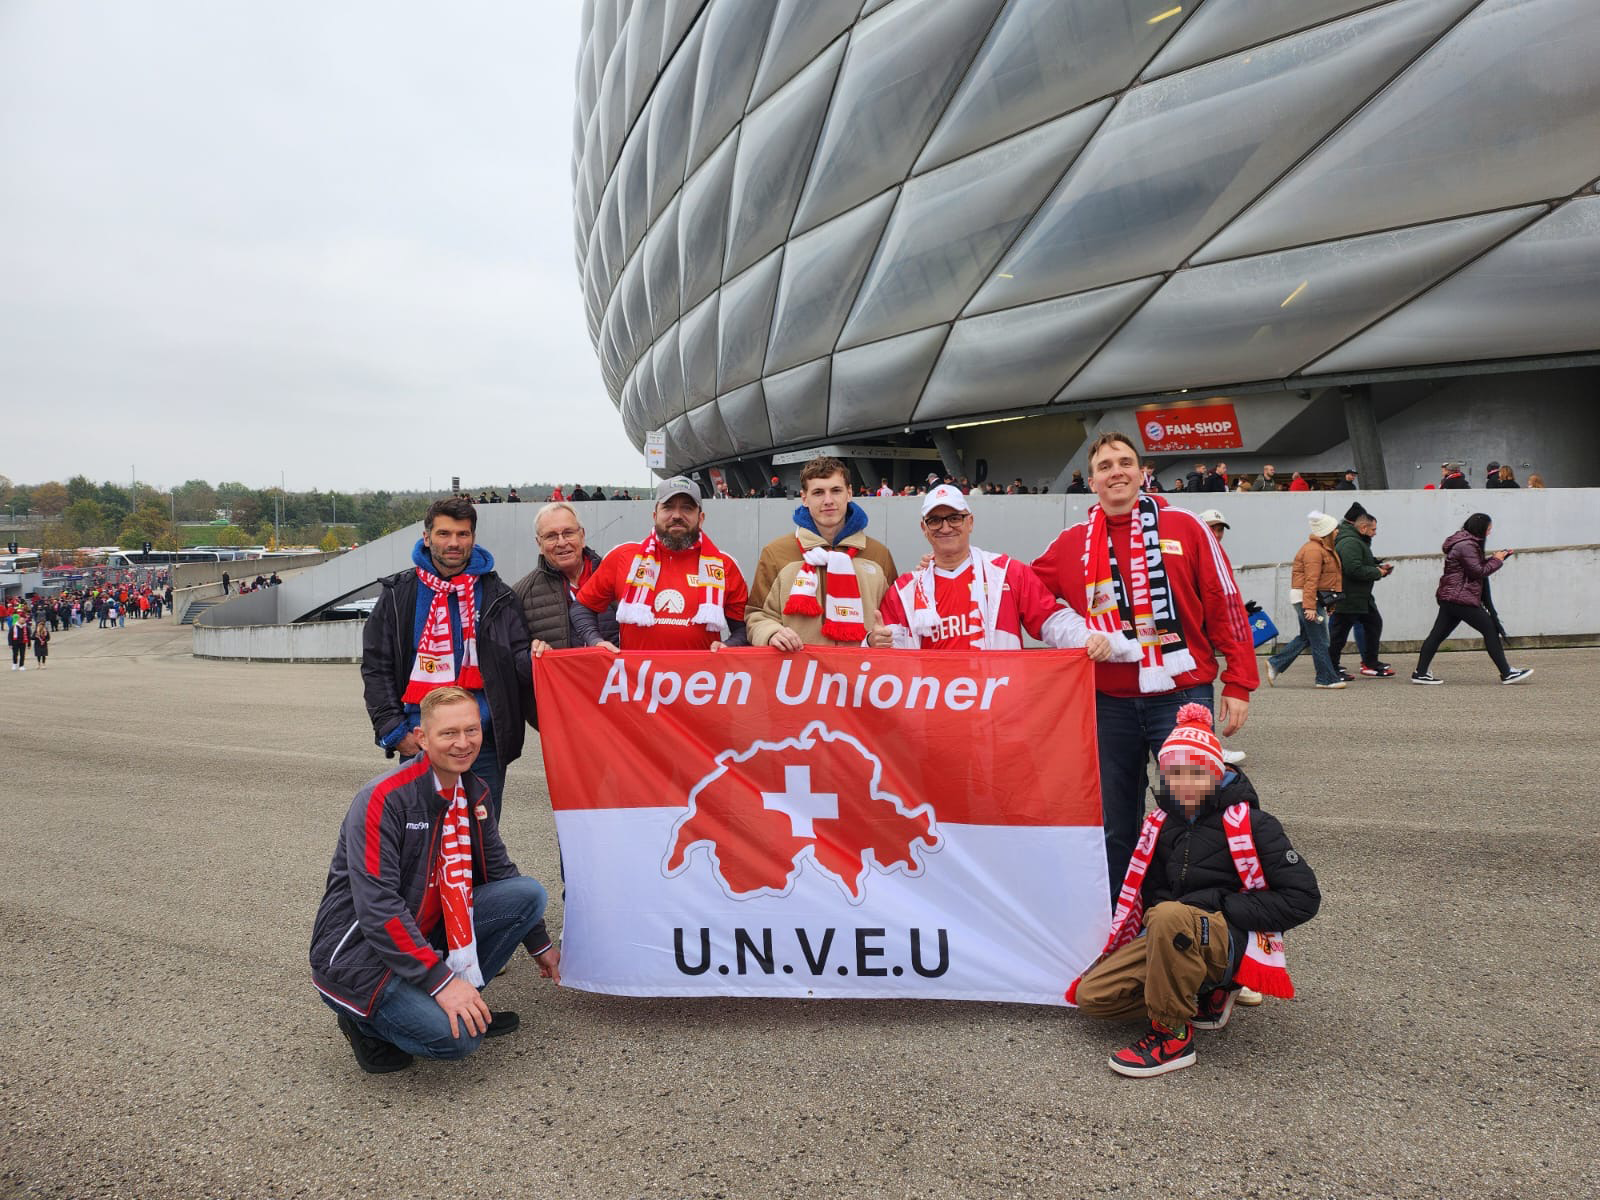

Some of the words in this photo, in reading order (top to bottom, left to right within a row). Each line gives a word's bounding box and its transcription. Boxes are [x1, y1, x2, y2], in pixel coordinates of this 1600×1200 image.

[1165, 421, 1232, 436] FAN-SHOP
[931, 613, 971, 643] BERL
[598, 658, 752, 713] Alpen
[775, 659, 1009, 711] Unioner
[673, 927, 950, 978] U.N.V.E.U
